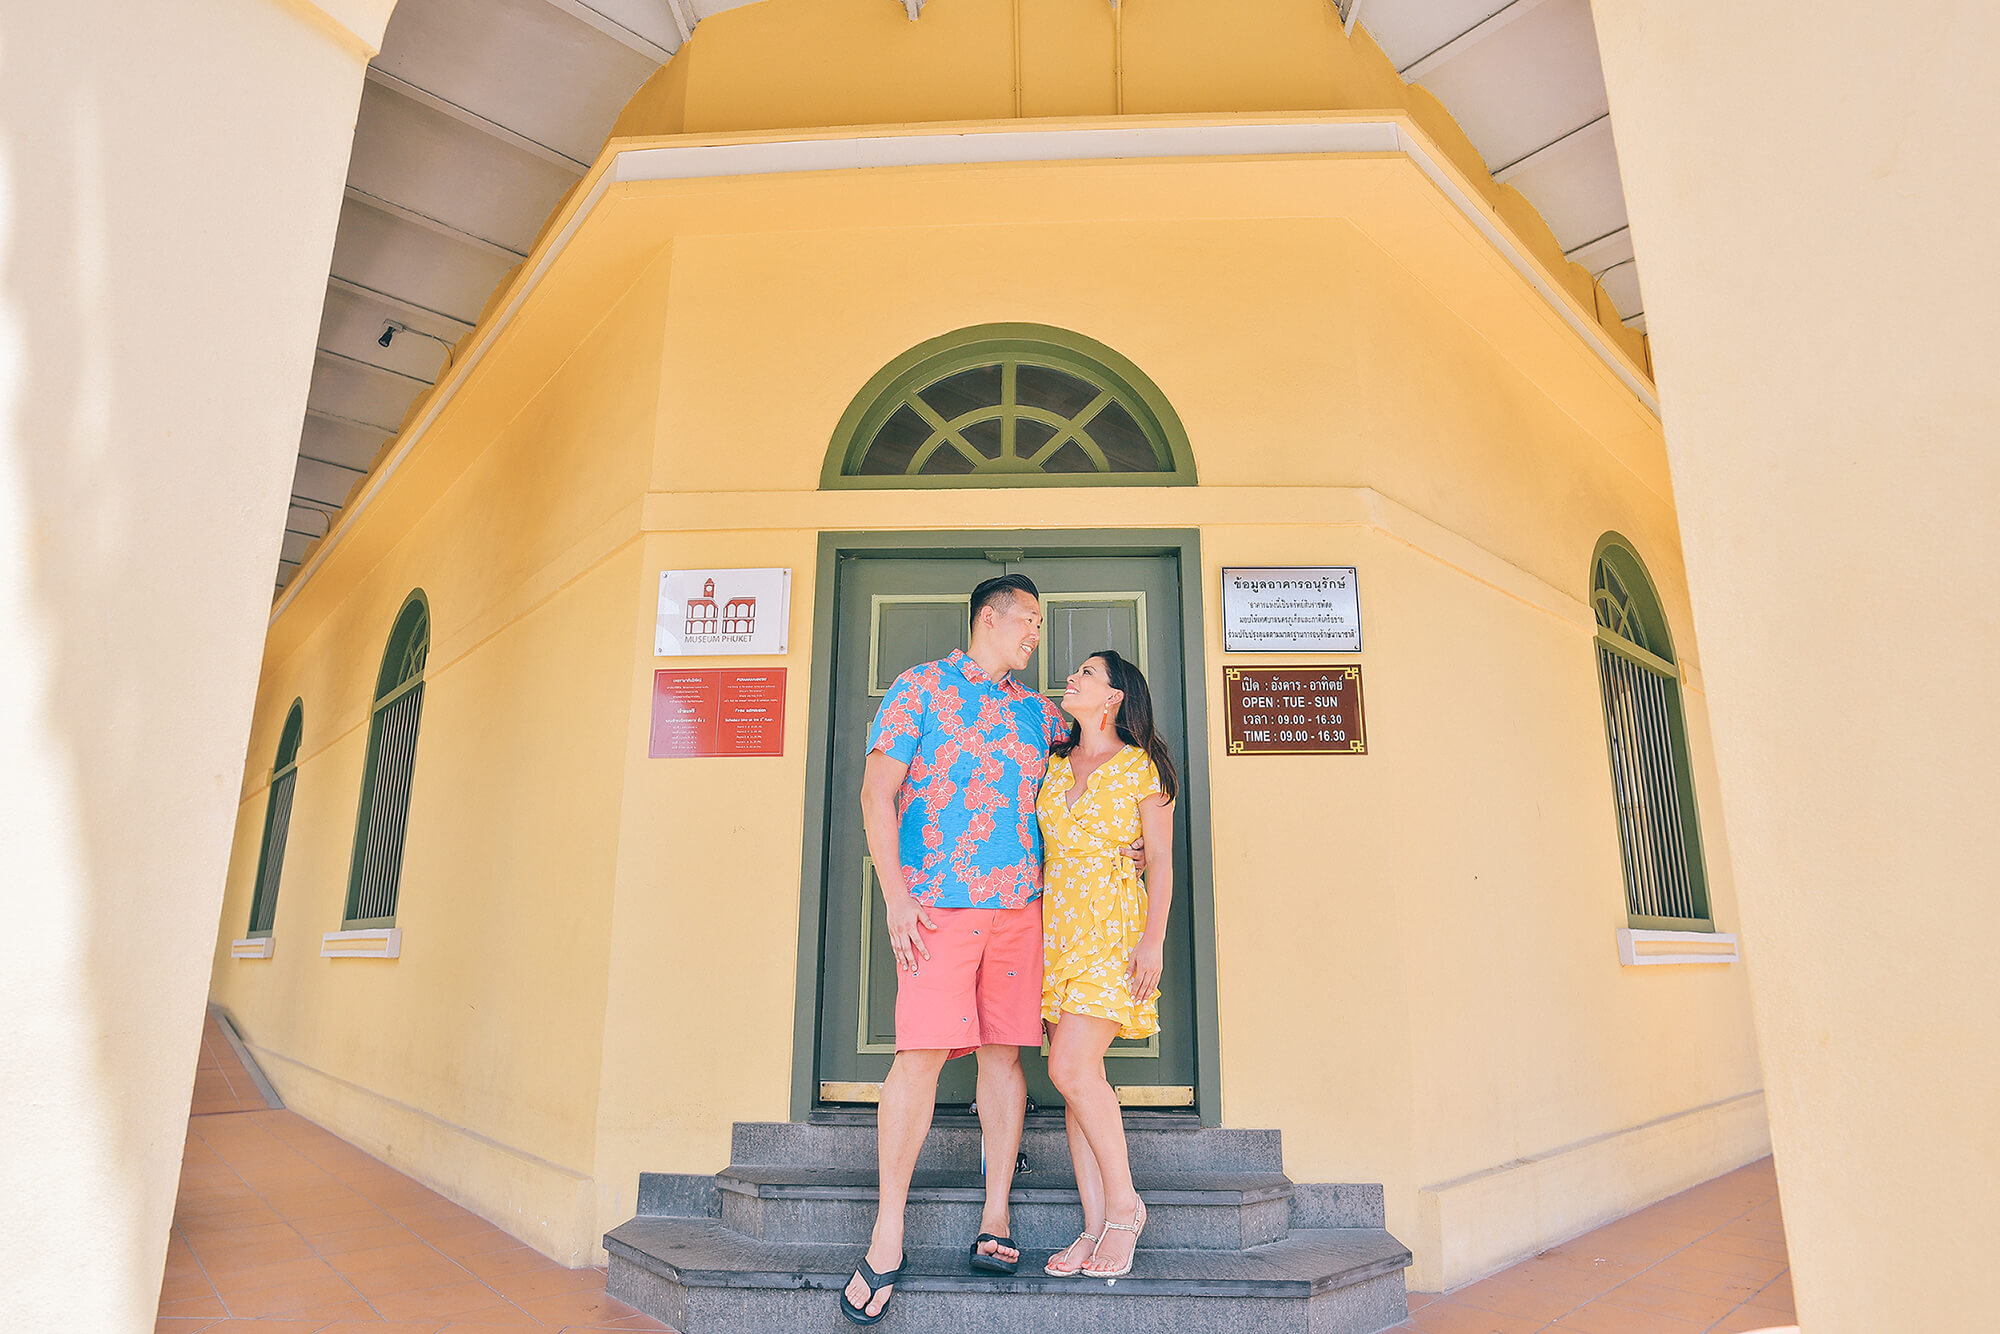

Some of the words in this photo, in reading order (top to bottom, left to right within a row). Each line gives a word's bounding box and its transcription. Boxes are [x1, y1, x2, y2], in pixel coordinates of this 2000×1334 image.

[1233, 576, 1346, 592] ข้อมูลอาคารอนุรักษ์
[684, 635, 720, 643] MUSEUM
[721, 635, 752, 643] PHUKET
[1241, 676, 1260, 691] เปิด
[1271, 676, 1301, 691] อังคาร
[1309, 675, 1344, 691] อาทิตย์
[1242, 697, 1274, 707] OPEN
[1283, 696, 1306, 707] TUE
[1314, 696, 1338, 707] SUN
[1243, 715, 1268, 724] เวลา
[1277, 715, 1305, 724] 09.00
[1315, 714, 1342, 724] 16.30
[1244, 731, 1271, 741] TIME
[1280, 731, 1308, 741] 09.00
[1317, 730, 1345, 741] 16.30
